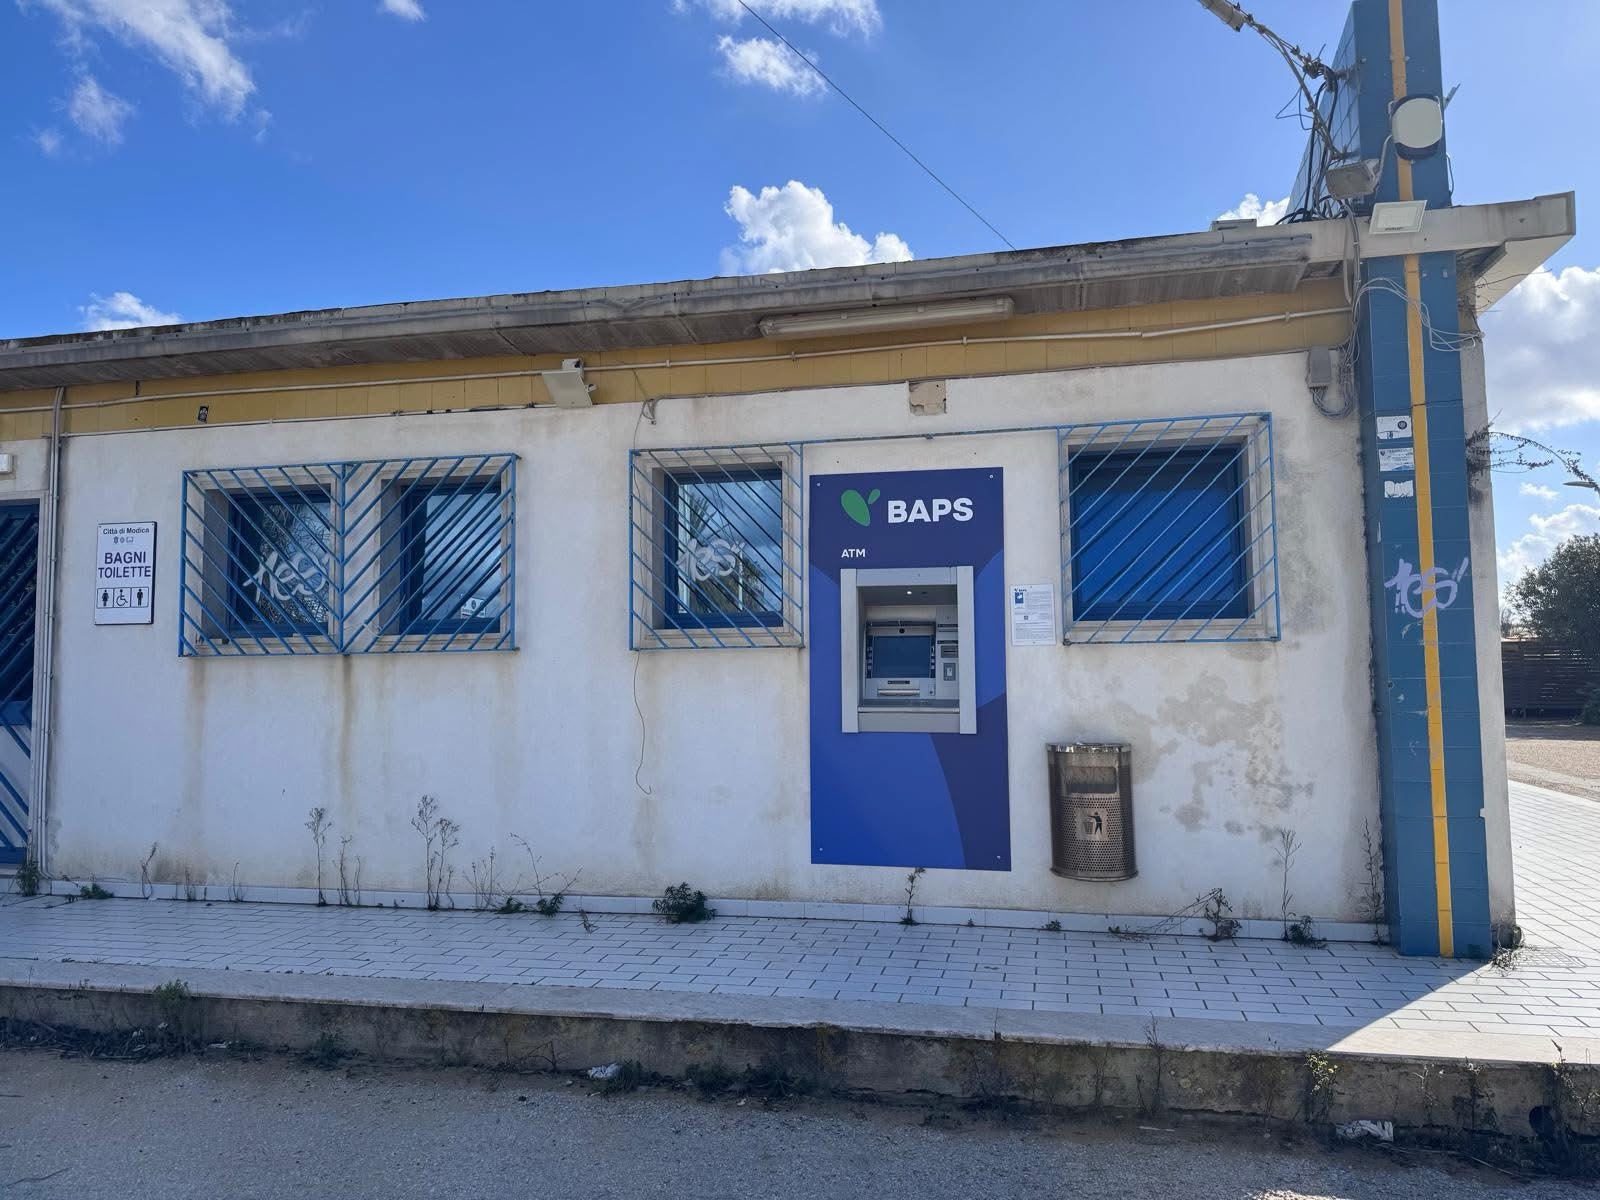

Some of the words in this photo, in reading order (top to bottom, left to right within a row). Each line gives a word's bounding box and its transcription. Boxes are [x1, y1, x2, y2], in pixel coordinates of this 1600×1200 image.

[887, 497, 974, 524] BAPS
[102, 527, 118, 535] Città
[104, 551, 146, 564] BAGNI
[841, 548, 866, 558] ATM
[98, 565, 152, 579] TOILETTE
